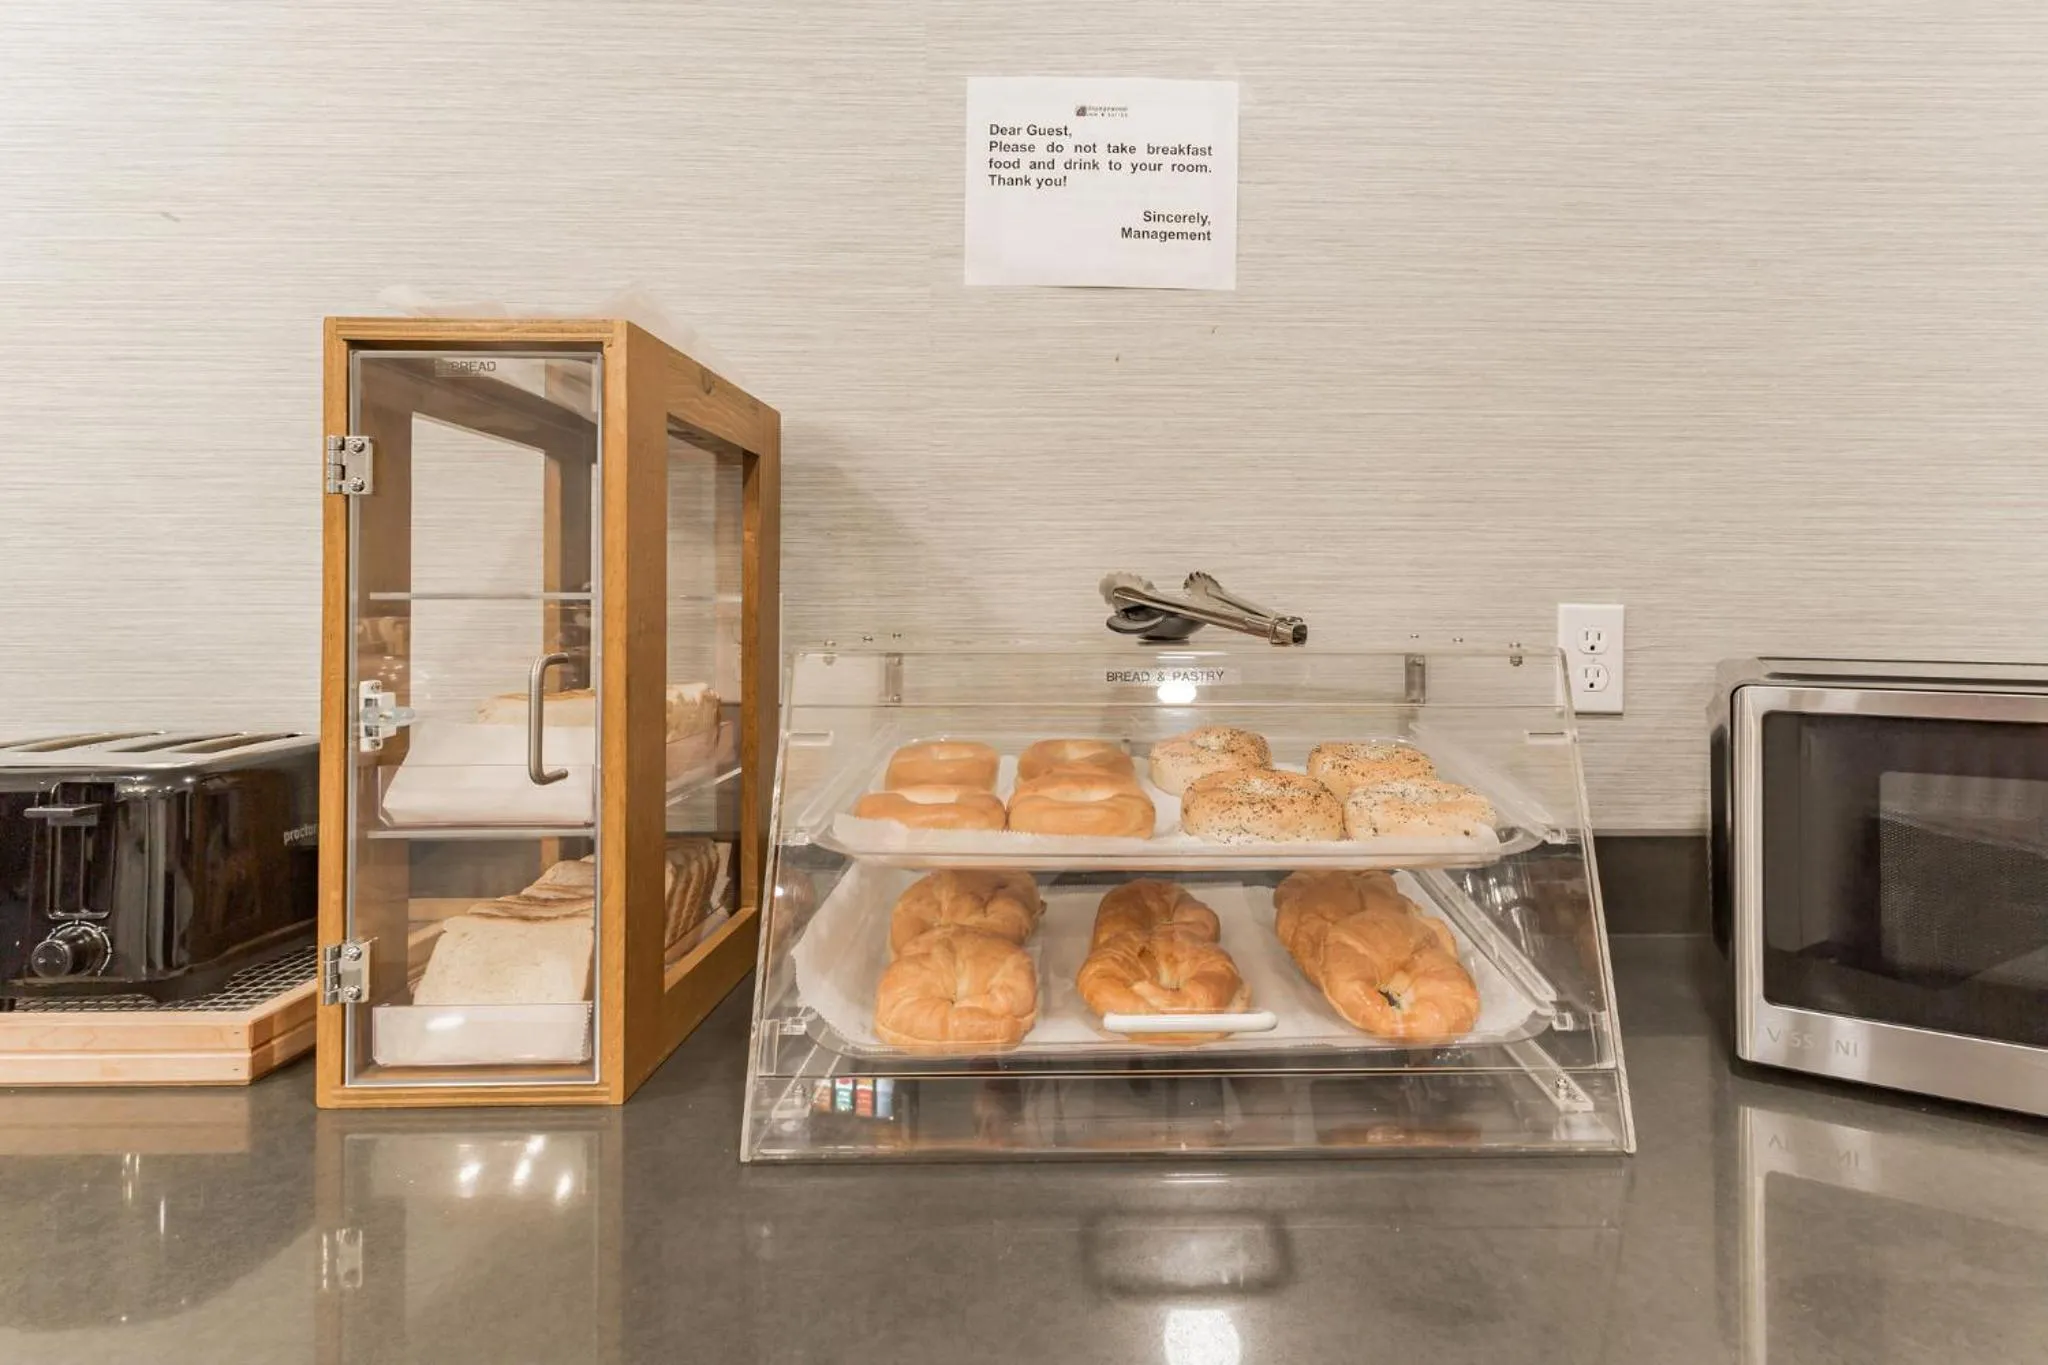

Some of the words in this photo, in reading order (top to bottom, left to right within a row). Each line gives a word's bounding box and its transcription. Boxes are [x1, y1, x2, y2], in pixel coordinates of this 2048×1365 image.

[989, 123, 1023, 137] Dear
[1026, 123, 1073, 139] Guest,
[988, 140, 1036, 154] Please
[1046, 141, 1065, 154] do
[1073, 142, 1098, 154] not
[1106, 142, 1137, 155] take
[1146, 142, 1213, 157] breakfast
[988, 157, 1021, 170] food
[1029, 158, 1056, 171] and
[1063, 158, 1100, 171] drink
[1107, 159, 1123, 172] to
[1130, 161, 1164, 175] your
[1171, 162, 1212, 174] room.
[988, 174, 1032, 187] Thank
[1035, 175, 1068, 190] you!
[1142, 210, 1212, 226] Sincerely,
[1120, 226, 1212, 243] Management
[450, 361, 497, 372] BREAD
[1106, 671, 1151, 682] BREAD
[1157, 671, 1166, 682] &
[1172, 671, 1224, 682] PASTRY
[1766, 1026, 1859, 1058] VSSNI
